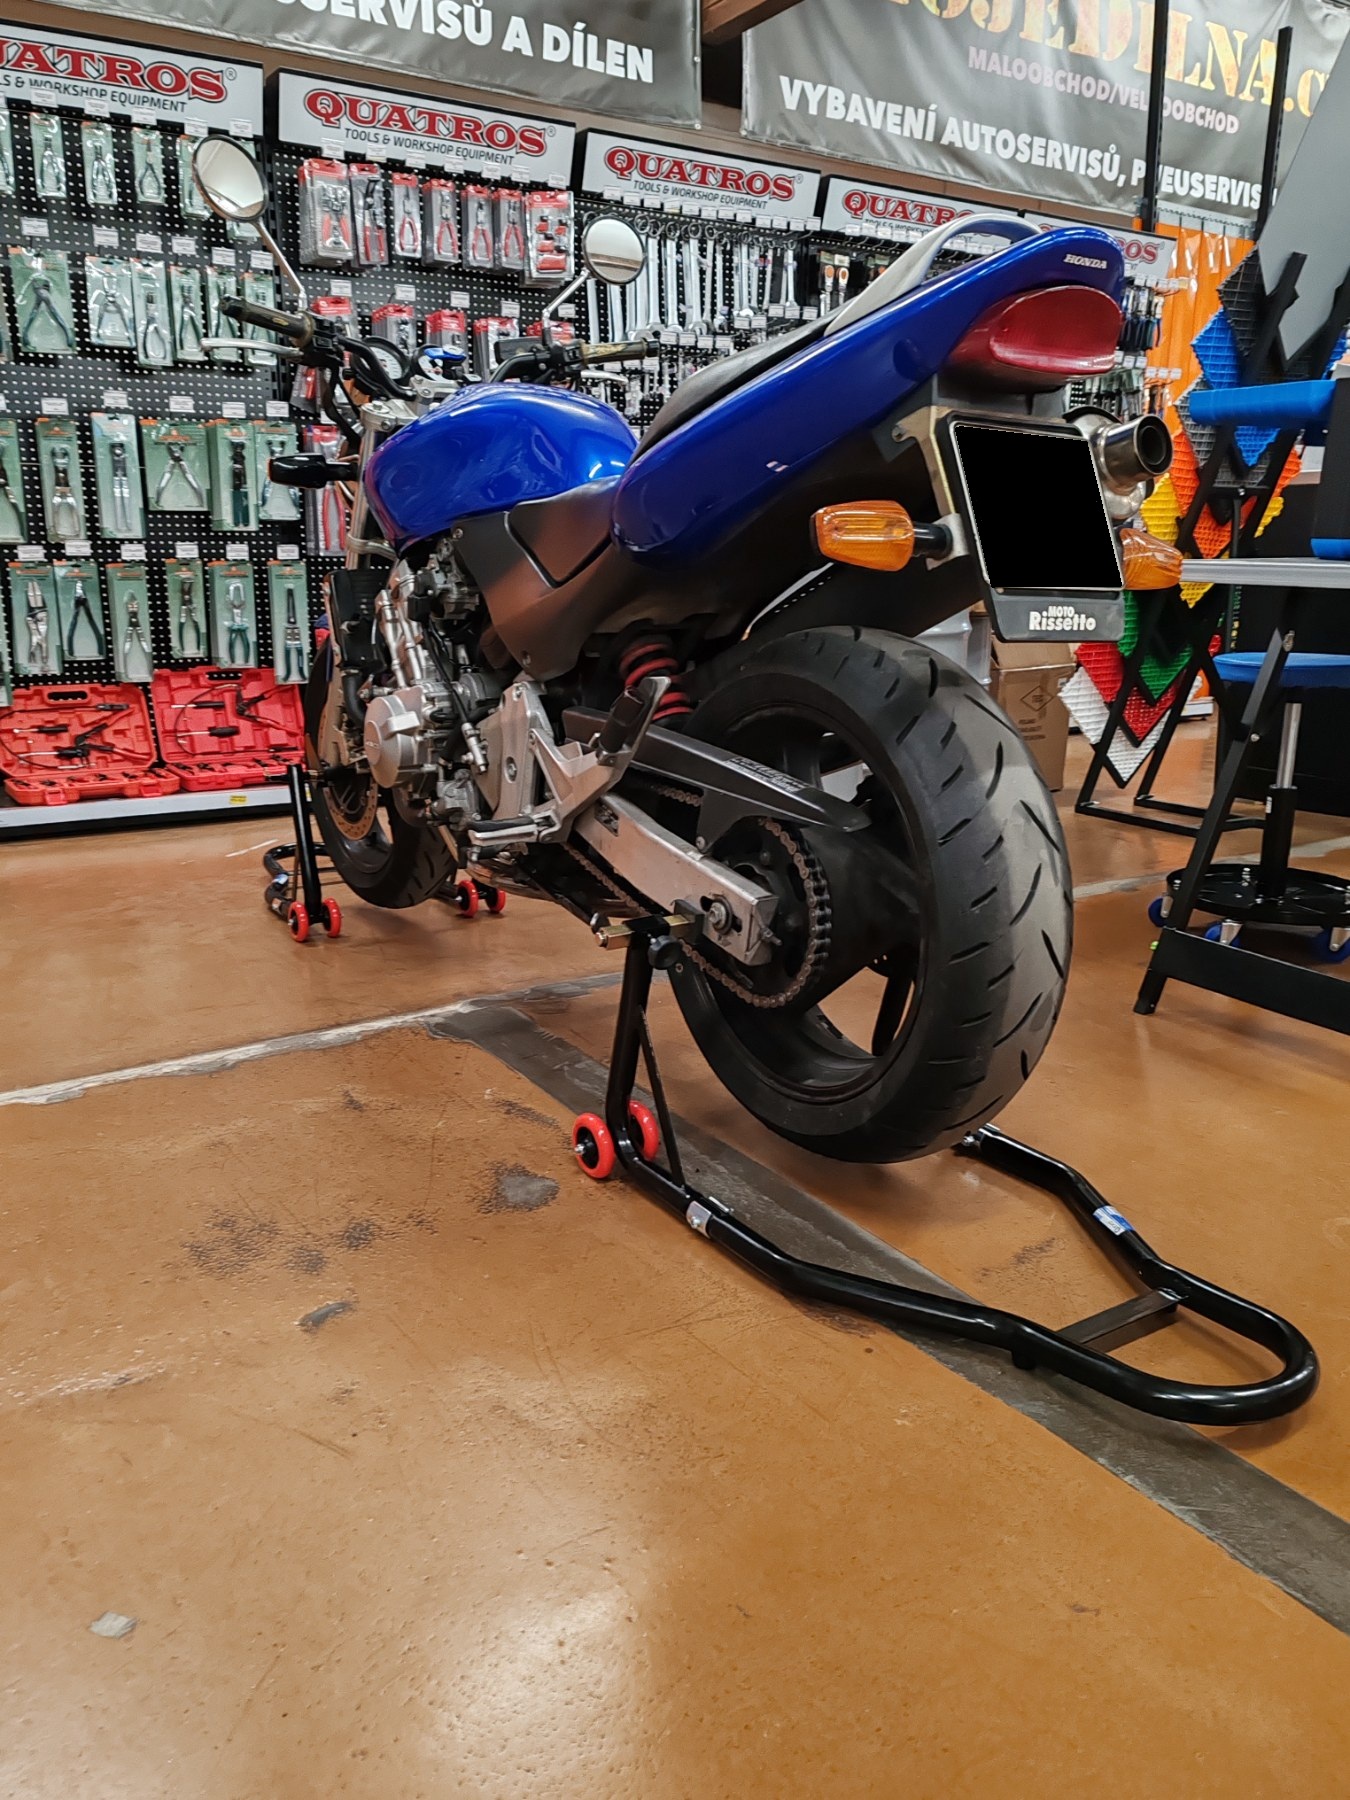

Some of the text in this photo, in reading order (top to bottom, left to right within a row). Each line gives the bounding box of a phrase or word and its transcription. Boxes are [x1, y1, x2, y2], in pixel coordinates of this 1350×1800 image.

[501, 16, 533, 57] A
[542, 22, 653, 83] DÍLEN
[0, 36, 228, 103] ATROS
[15, 76, 25, 88] &
[29, 78, 108, 98] WORKSHOP
[110, 90, 187, 113] EQUIPMENT
[967, 46, 1239, 134] MALOOBCHOD/VELOOBCHOD
[304, 88, 547, 157] QUATROS
[779, 76, 937, 142] VYBAVENÍ
[940, 116, 1127, 187] AUTOSERVISŮ,
[344, 128, 515, 166] TOOLS & WORKSHOP EQUIPMENT
[604, 145, 796, 201] QUATROS
[633, 180, 768, 210] TOOLS & WORKSHOP EQUIPMENT
[843, 189, 976, 227] QUATR
[1063, 253, 1107, 269] HONDA
[1029, 611, 1097, 631] Rissetto
[1047, 605, 1075, 618] MOTO
